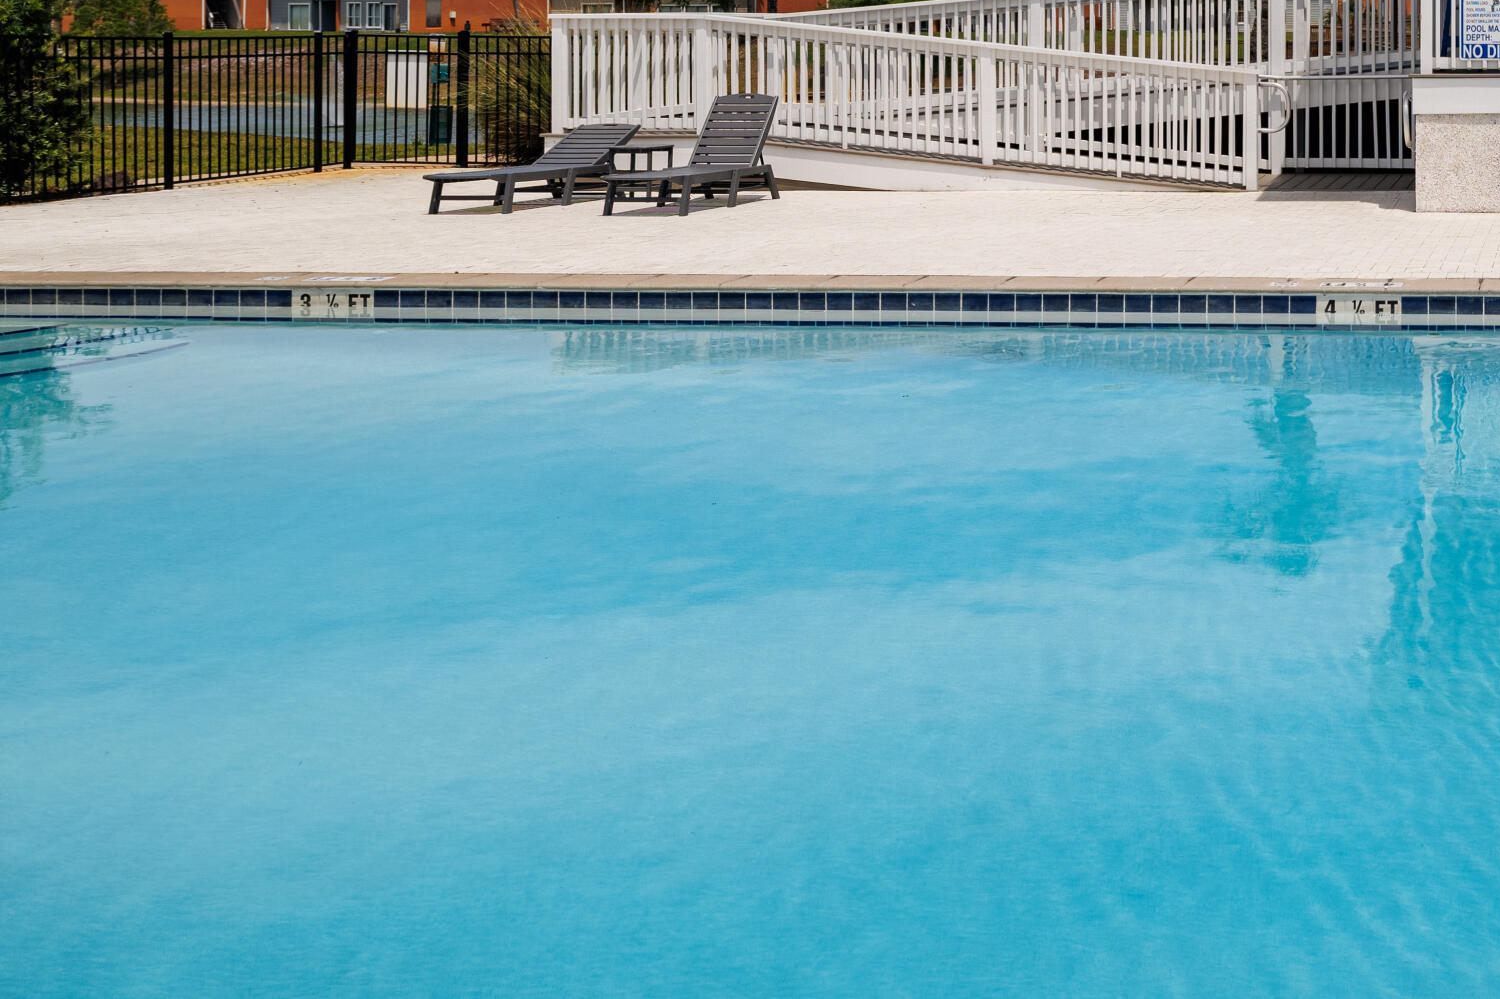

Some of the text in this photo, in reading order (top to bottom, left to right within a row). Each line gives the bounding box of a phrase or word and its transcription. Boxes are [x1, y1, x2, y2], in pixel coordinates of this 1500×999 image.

[1464, 45, 1483, 58] NO
[300, 293, 311, 307] 3
[348, 293, 371, 307] FT
[1325, 299, 1336, 314] 4
[1375, 299, 1398, 314] FT
